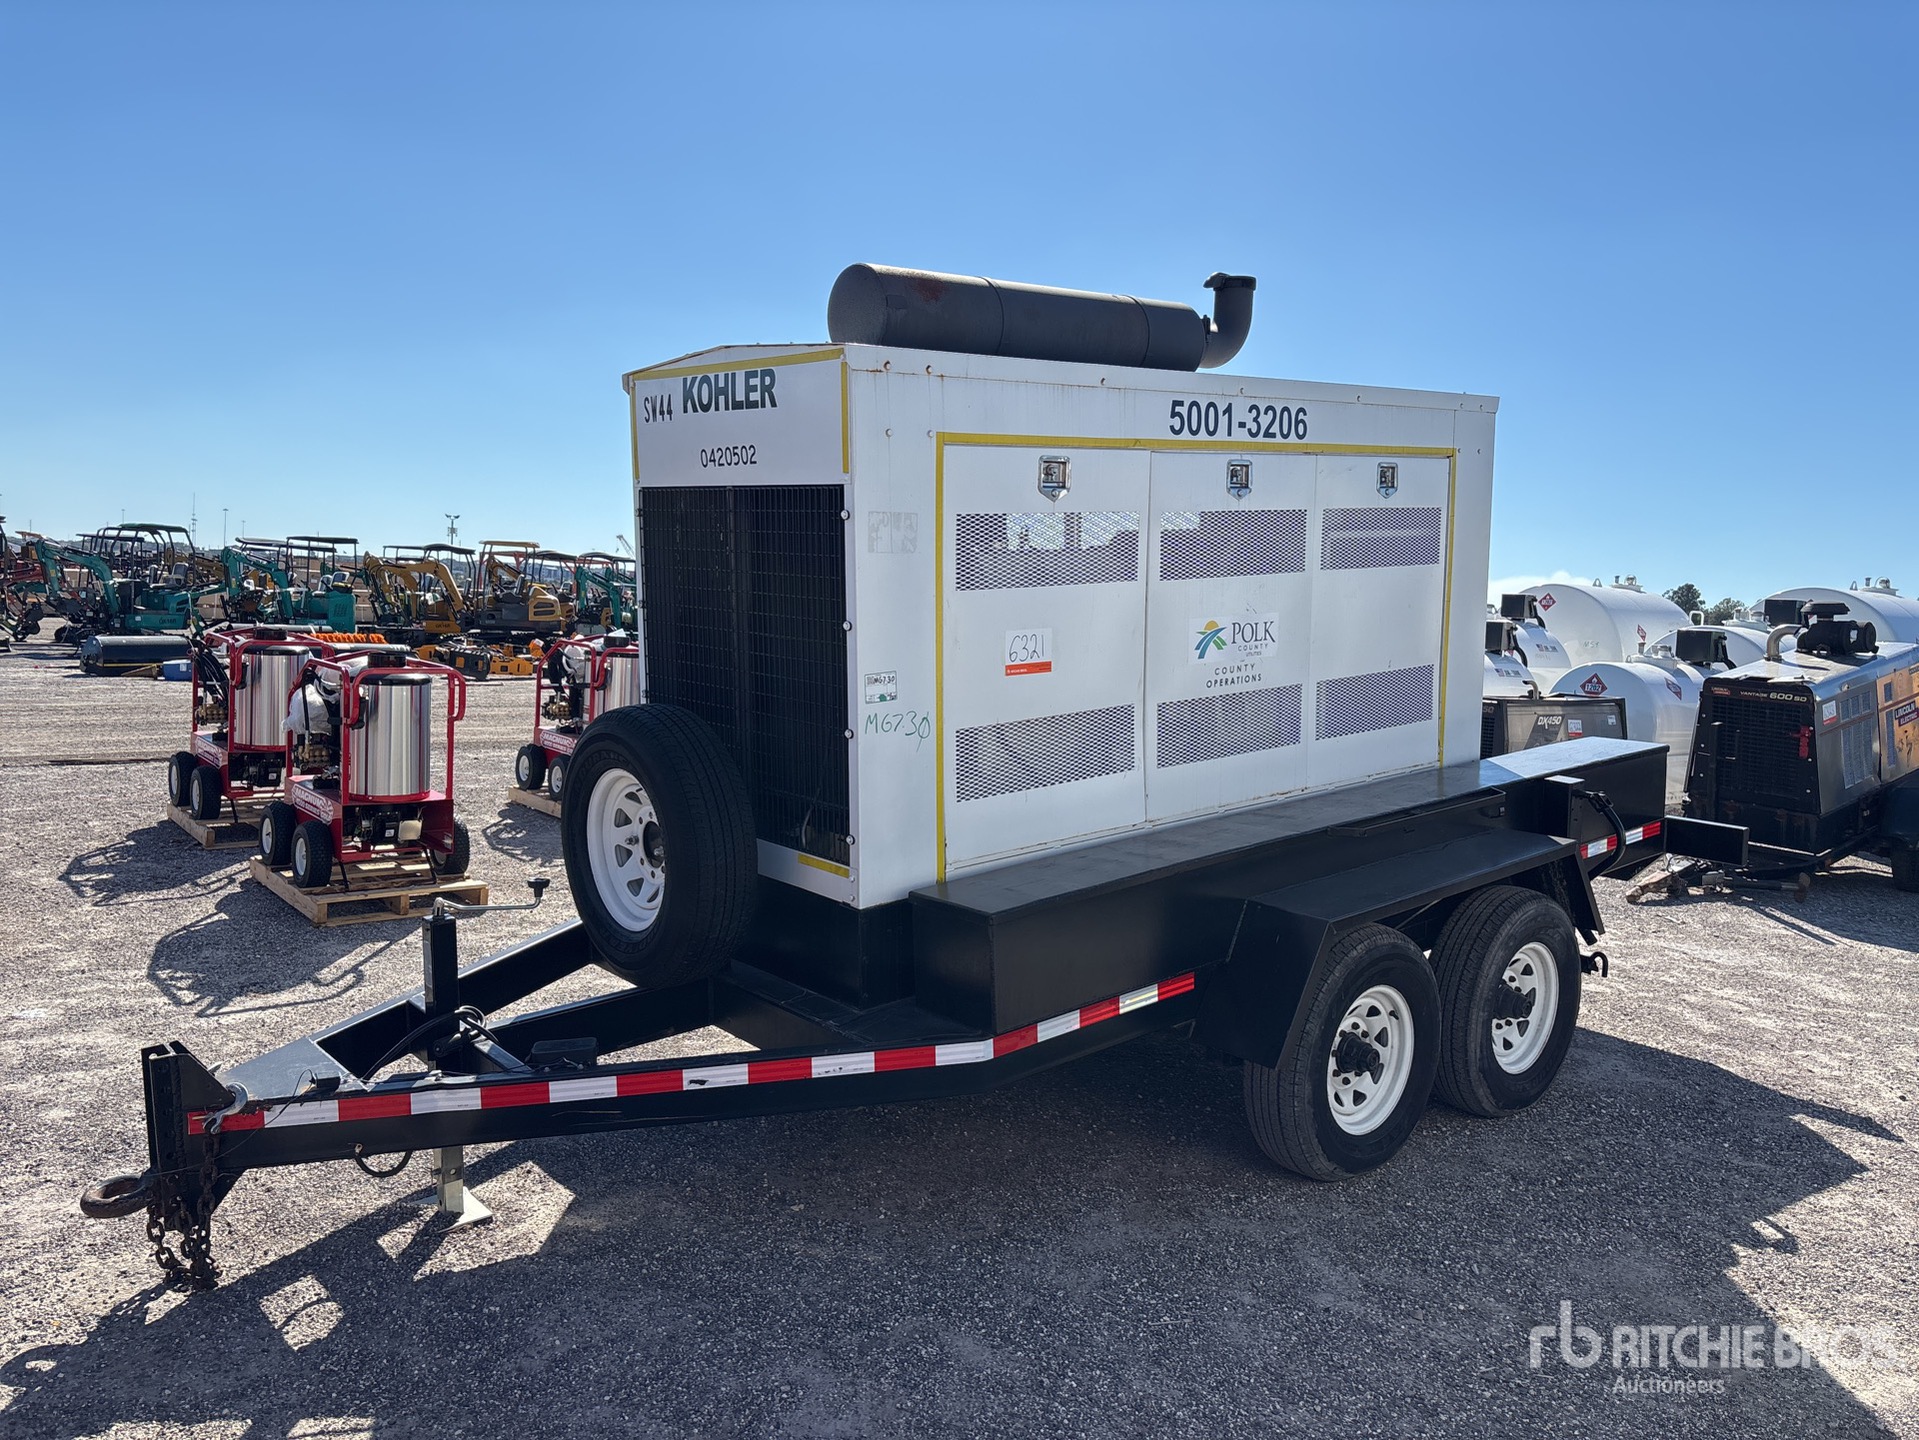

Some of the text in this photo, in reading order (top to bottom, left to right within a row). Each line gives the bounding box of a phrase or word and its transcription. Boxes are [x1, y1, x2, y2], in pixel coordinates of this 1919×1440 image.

[643, 368, 778, 424] SW44 KOHLER
[1169, 399, 1308, 441] 5001-3206
[700, 444, 757, 468] 0420502
[1231, 620, 1276, 645] POLK
[1008, 633, 1045, 663] 6321
[1237, 643, 1268, 652] COUNTY
[1214, 663, 1256, 676] COUNTY
[1205, 673, 1262, 688] OPERATIONS
[1585, 683, 1601, 692] 1202
[1769, 692, 1793, 701] 600
[1895, 702, 1916, 719] LINCOLN
[1900, 711, 1918, 724] ELECTRIC
[1537, 716, 1562, 729] DX450
[295, 786, 323, 808] MAGNUM
